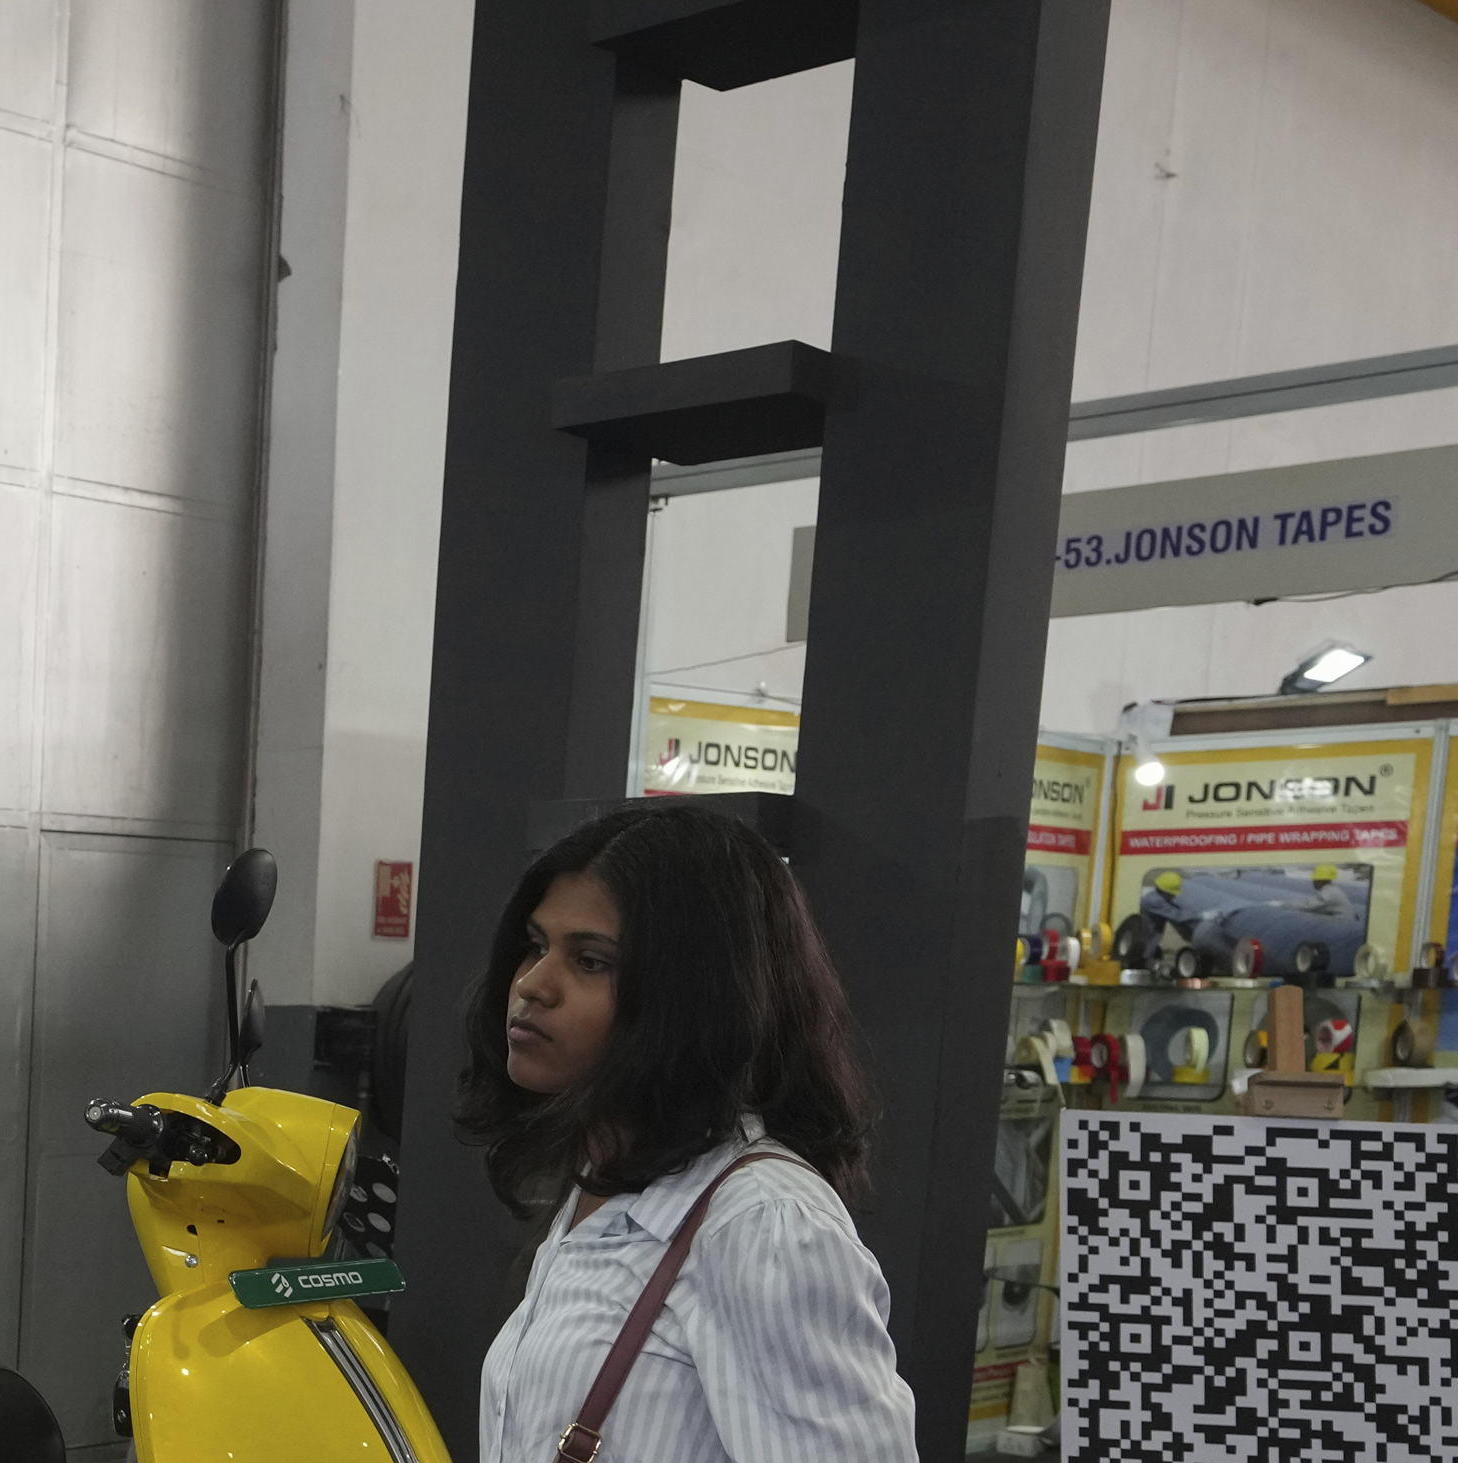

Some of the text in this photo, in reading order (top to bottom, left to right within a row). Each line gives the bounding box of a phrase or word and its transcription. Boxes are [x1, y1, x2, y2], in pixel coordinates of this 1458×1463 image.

[1274, 499, 1392, 547] TAPES
[689, 741, 797, 773] JONSON
[1130, 836, 1237, 849] WATERPROOFING
[1247, 832, 1276, 845] PIPE
[1279, 830, 1350, 844] WRAPPING
